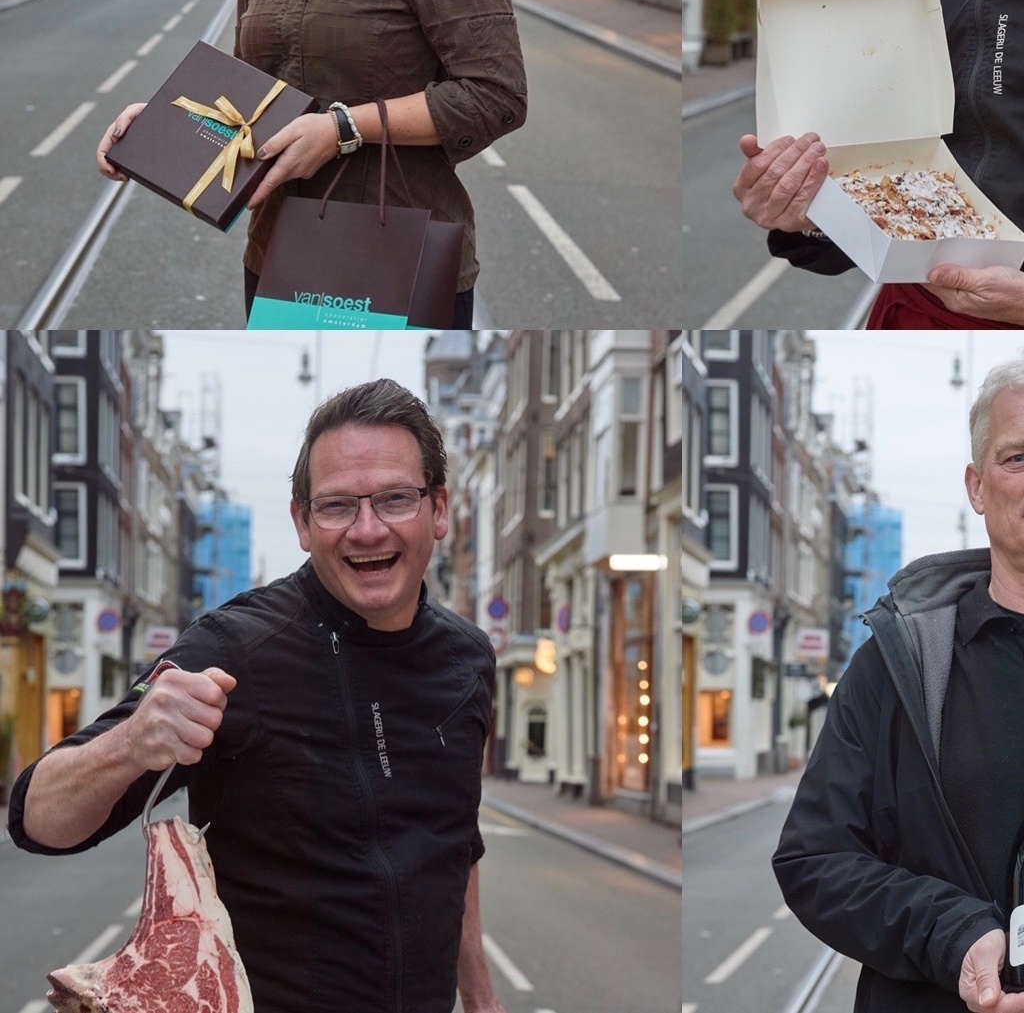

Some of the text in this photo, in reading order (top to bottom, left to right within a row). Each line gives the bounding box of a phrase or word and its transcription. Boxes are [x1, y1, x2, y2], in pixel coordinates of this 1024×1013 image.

[994, 51, 1004, 64] DE
[992, 65, 1003, 95] LEEUW
[204, 118, 239, 141] soest
[200, 132, 228, 149] amsterda
[294, 291, 372, 313] van soest
[323, 319, 367, 329] amsterdam
[376, 738, 387, 751] DE
[378, 751, 393, 778] LEEUW
